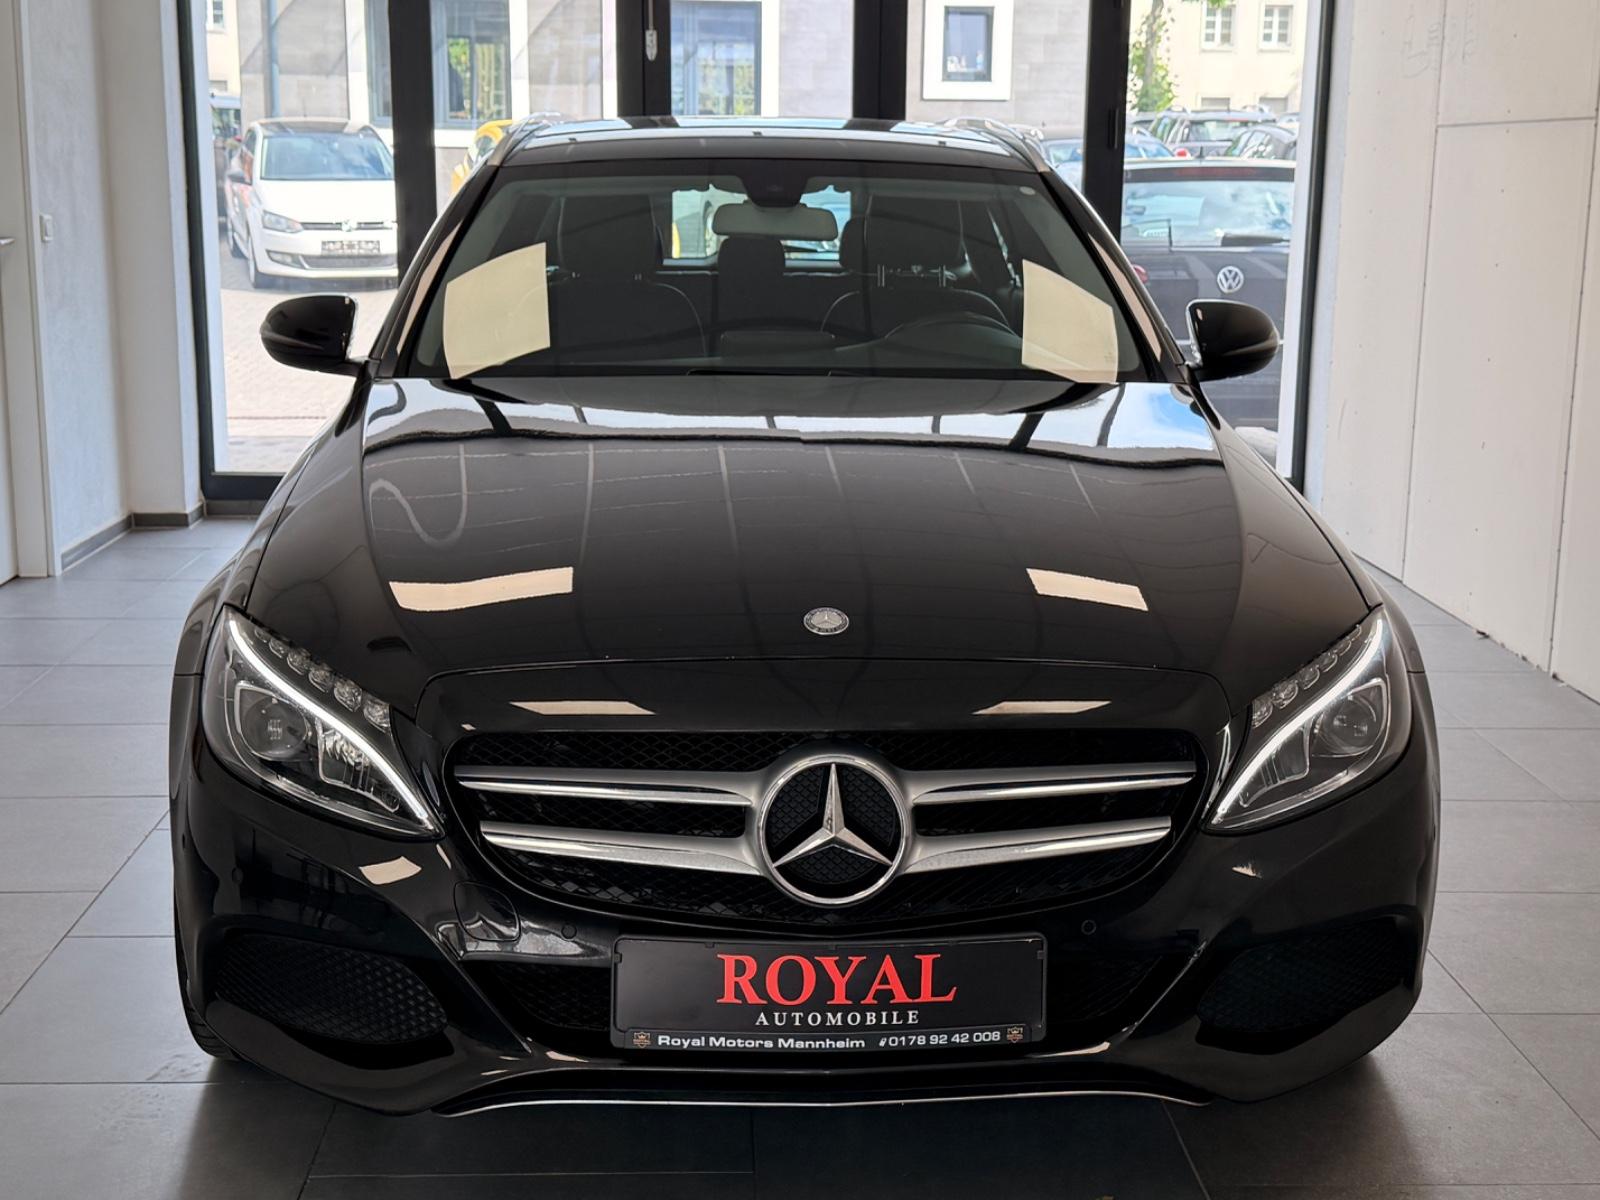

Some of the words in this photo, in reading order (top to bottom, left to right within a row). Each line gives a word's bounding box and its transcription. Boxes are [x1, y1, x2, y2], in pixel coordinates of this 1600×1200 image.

[1217, 266, 1244, 293] VW
[716, 953, 957, 1006] ROYAL
[755, 1010, 920, 1026] AUTOMOBILE
[657, 1034, 705, 1049] Royal
[709, 1036, 774, 1048] Motors
[778, 1037, 866, 1049] Mannheim
[888, 1035, 926, 1047] 0178
[929, 1034, 948, 1045] 92
[951, 1033, 970, 1043] 42
[973, 1031, 1001, 1042] 008
